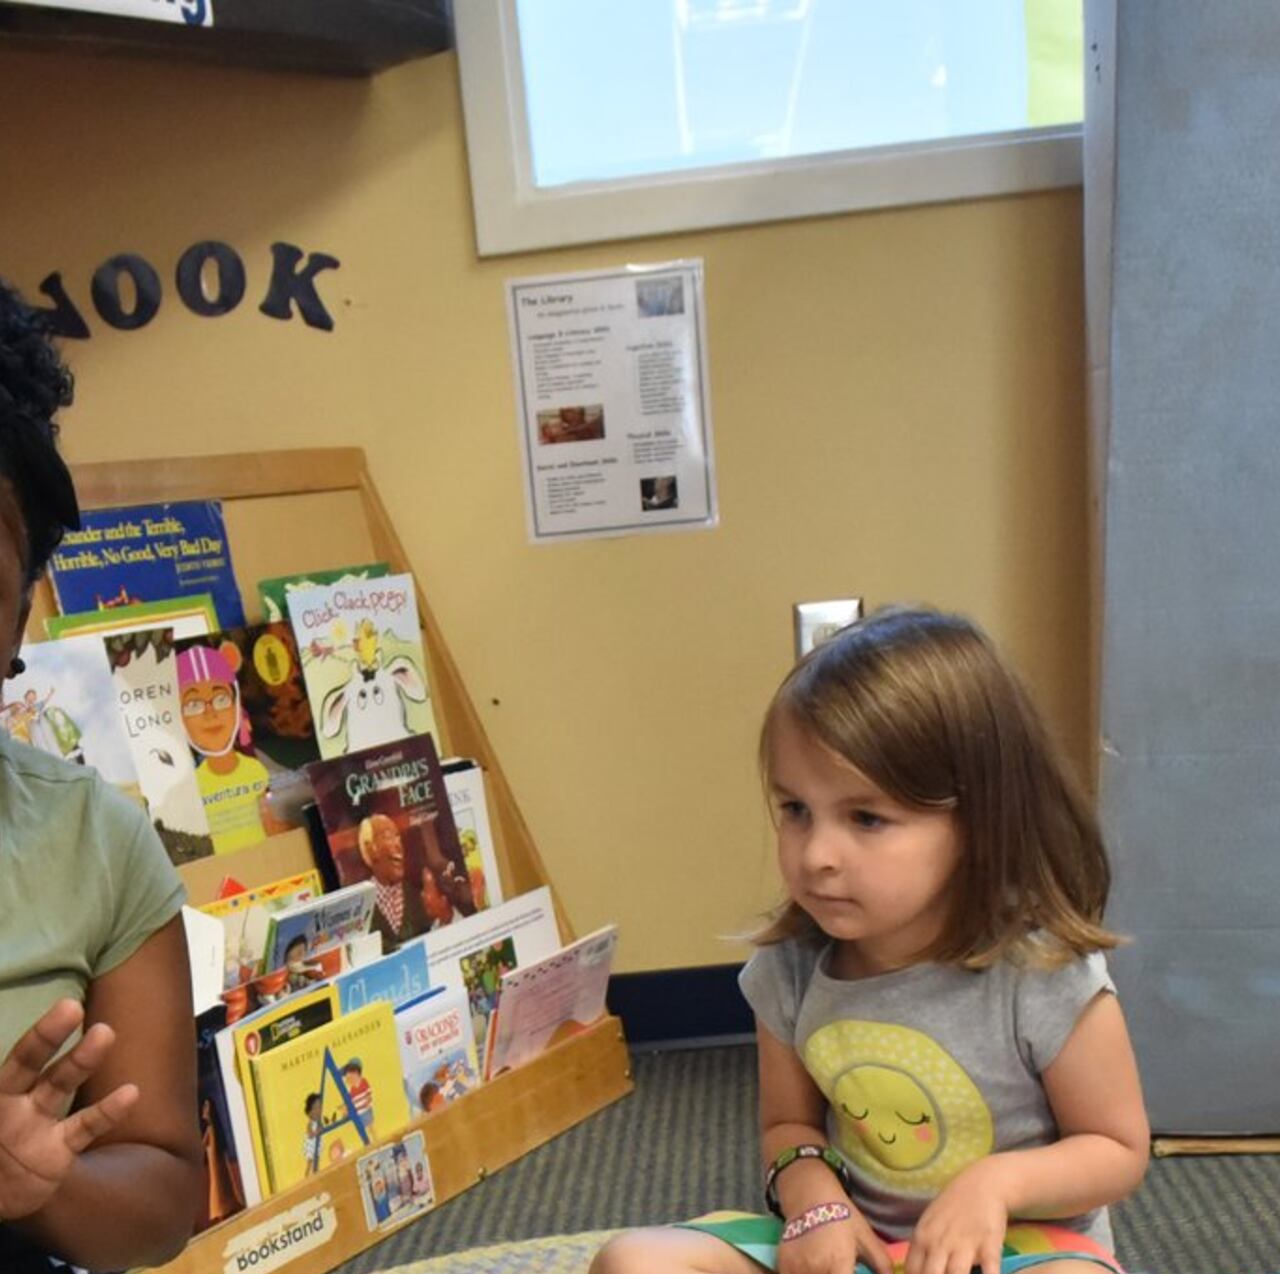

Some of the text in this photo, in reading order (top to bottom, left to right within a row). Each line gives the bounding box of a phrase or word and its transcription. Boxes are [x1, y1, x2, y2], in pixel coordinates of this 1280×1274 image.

[119, 682, 172, 706] OREN
[398, 780, 434, 807] FACE
[236, 1211, 324, 1271] Bookstand
